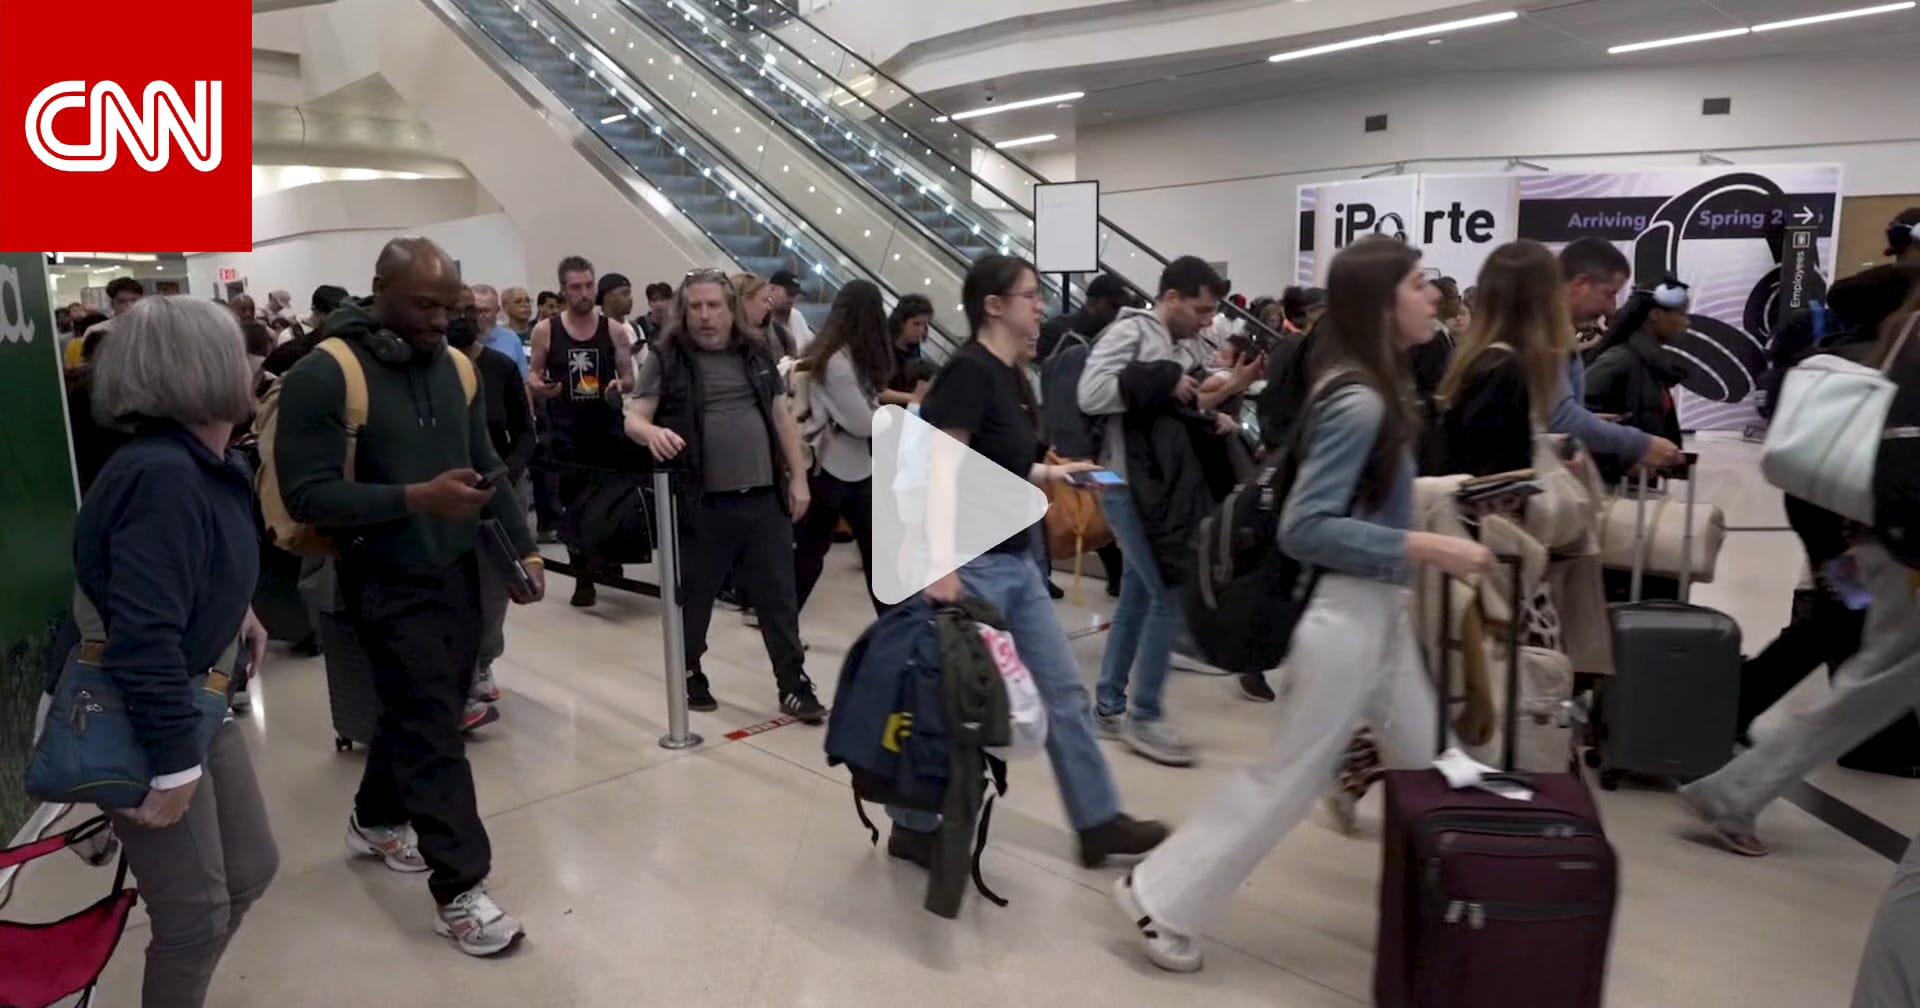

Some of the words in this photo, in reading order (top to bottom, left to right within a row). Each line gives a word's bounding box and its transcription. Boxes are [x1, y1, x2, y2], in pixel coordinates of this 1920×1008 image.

[1568, 211, 1647, 230] Arriving
[1699, 209, 1765, 229] Spring
[1790, 250, 1805, 308] Employees
